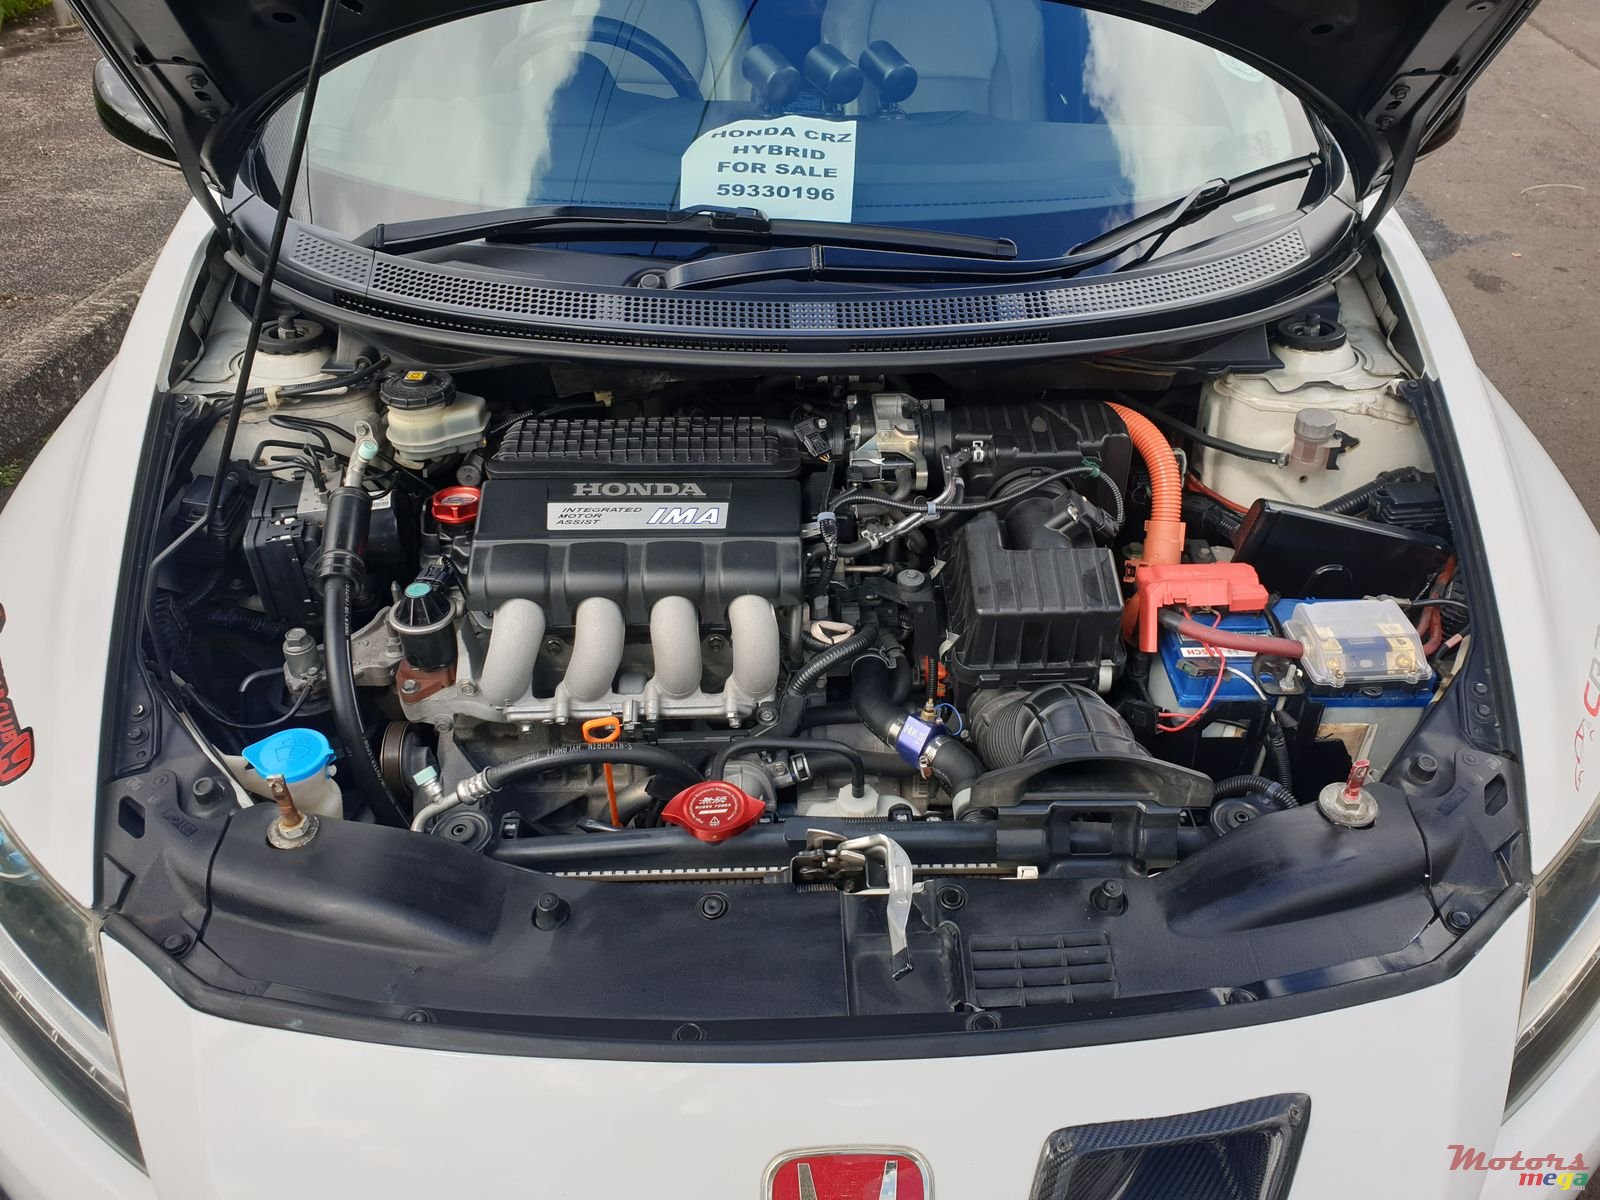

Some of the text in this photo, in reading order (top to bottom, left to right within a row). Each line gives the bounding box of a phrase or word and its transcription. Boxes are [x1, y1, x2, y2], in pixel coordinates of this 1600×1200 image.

[711, 127, 852, 143] HONDA CRZ
[732, 144, 826, 160] HYBRID
[717, 161, 838, 178] FOR SALE
[716, 183, 835, 201] 59330196
[572, 482, 707, 497] HONDA
[646, 507, 720, 525] IMA
